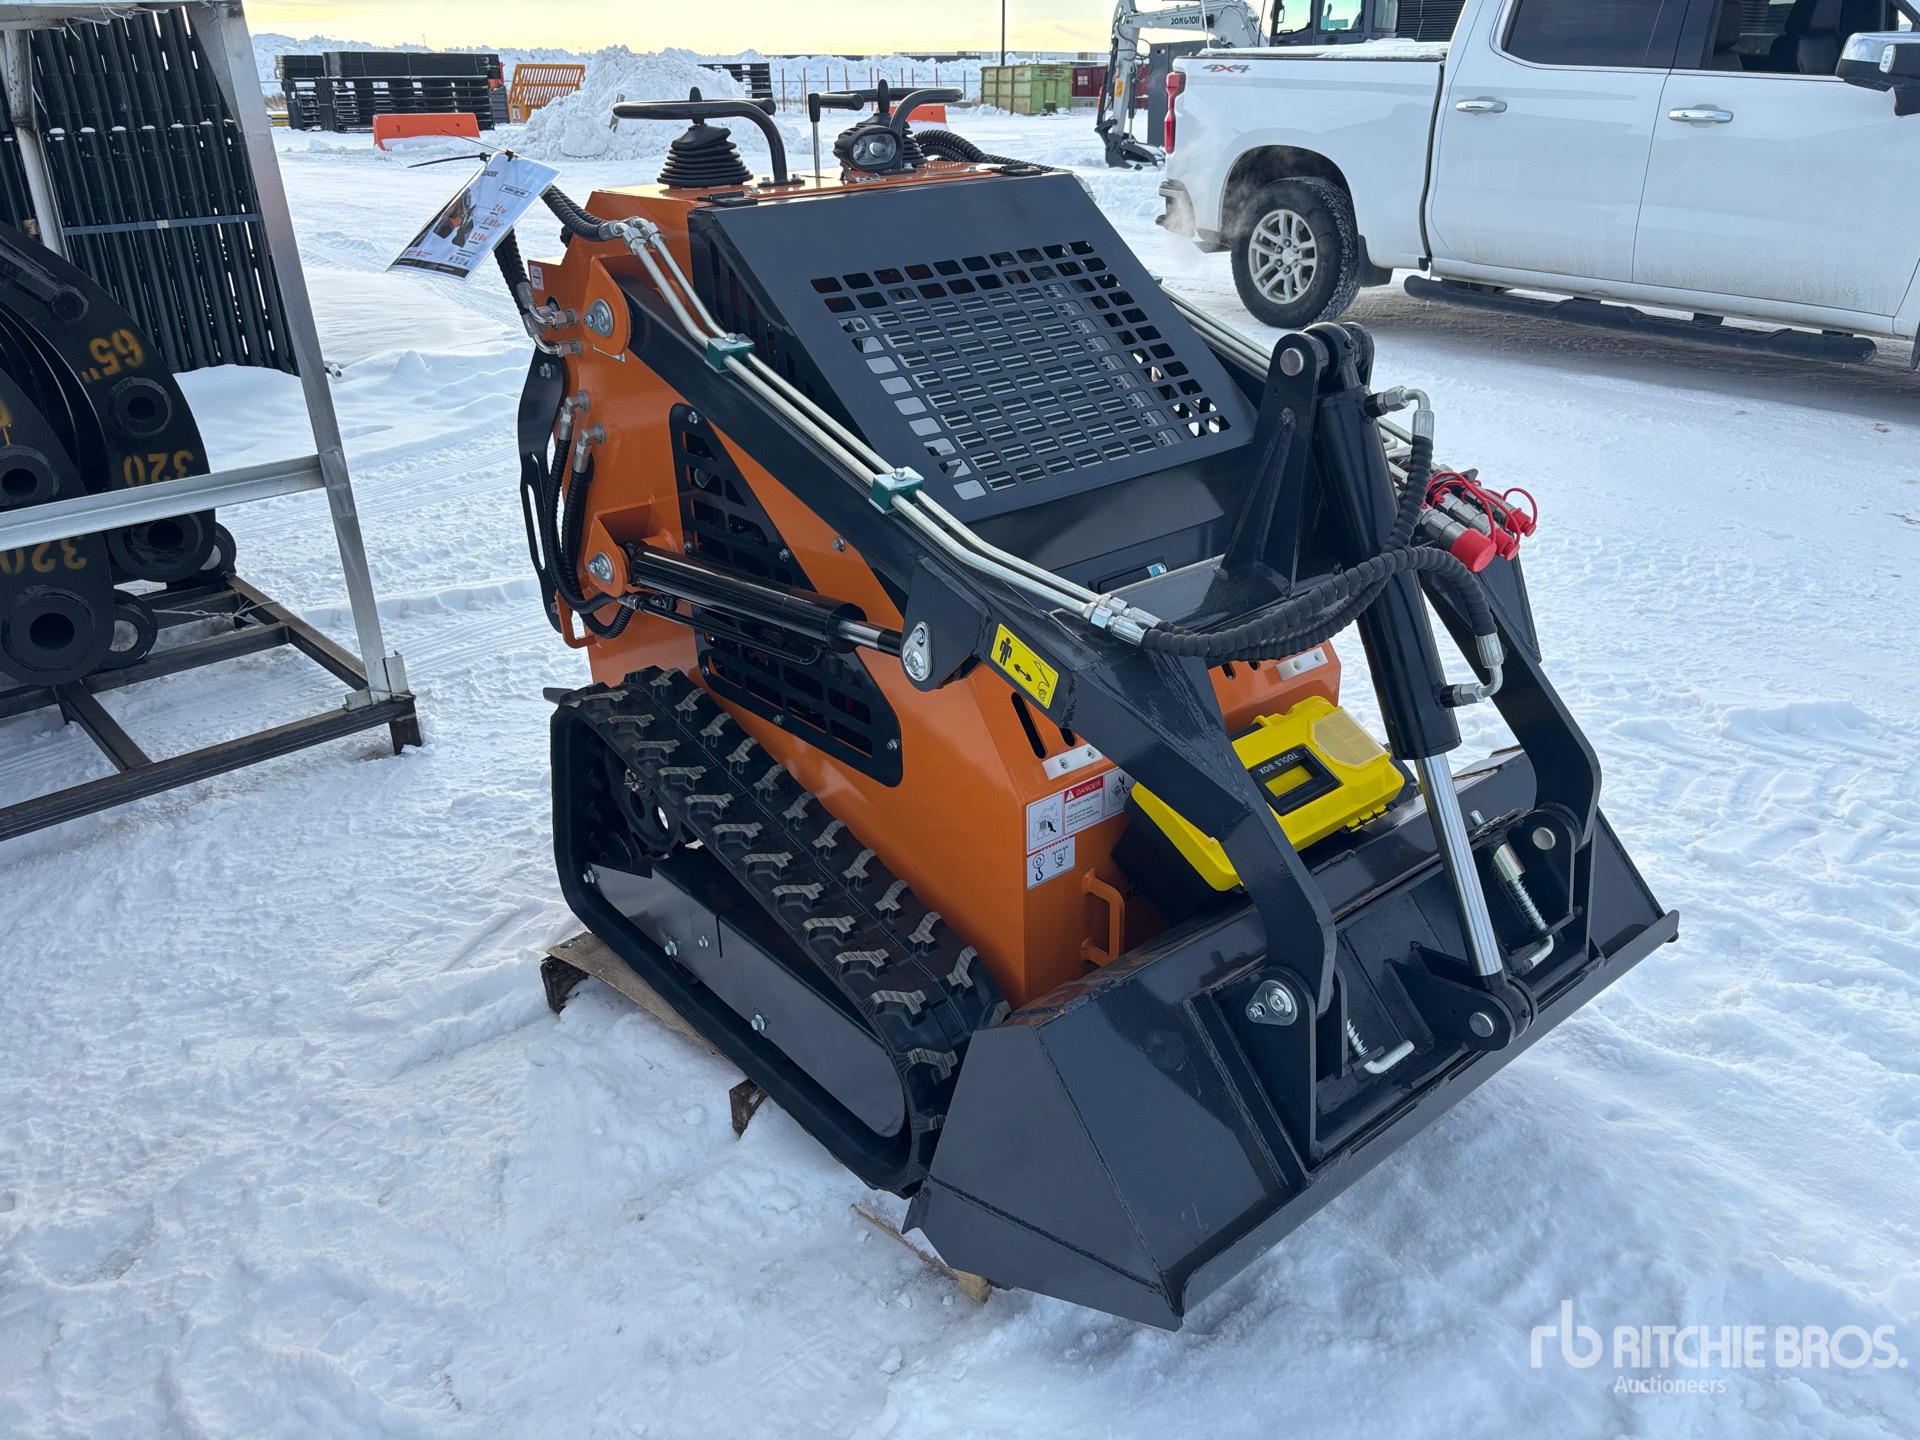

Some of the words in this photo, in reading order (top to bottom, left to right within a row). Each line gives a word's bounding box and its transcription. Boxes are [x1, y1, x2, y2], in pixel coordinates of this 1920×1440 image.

[123, 450, 194, 488] 320
[0, 535, 87, 576] 320
[1274, 752, 1299, 767] TOOLS
[1258, 763, 1275, 775] BOX
[1076, 780, 1101, 796] DANGER
